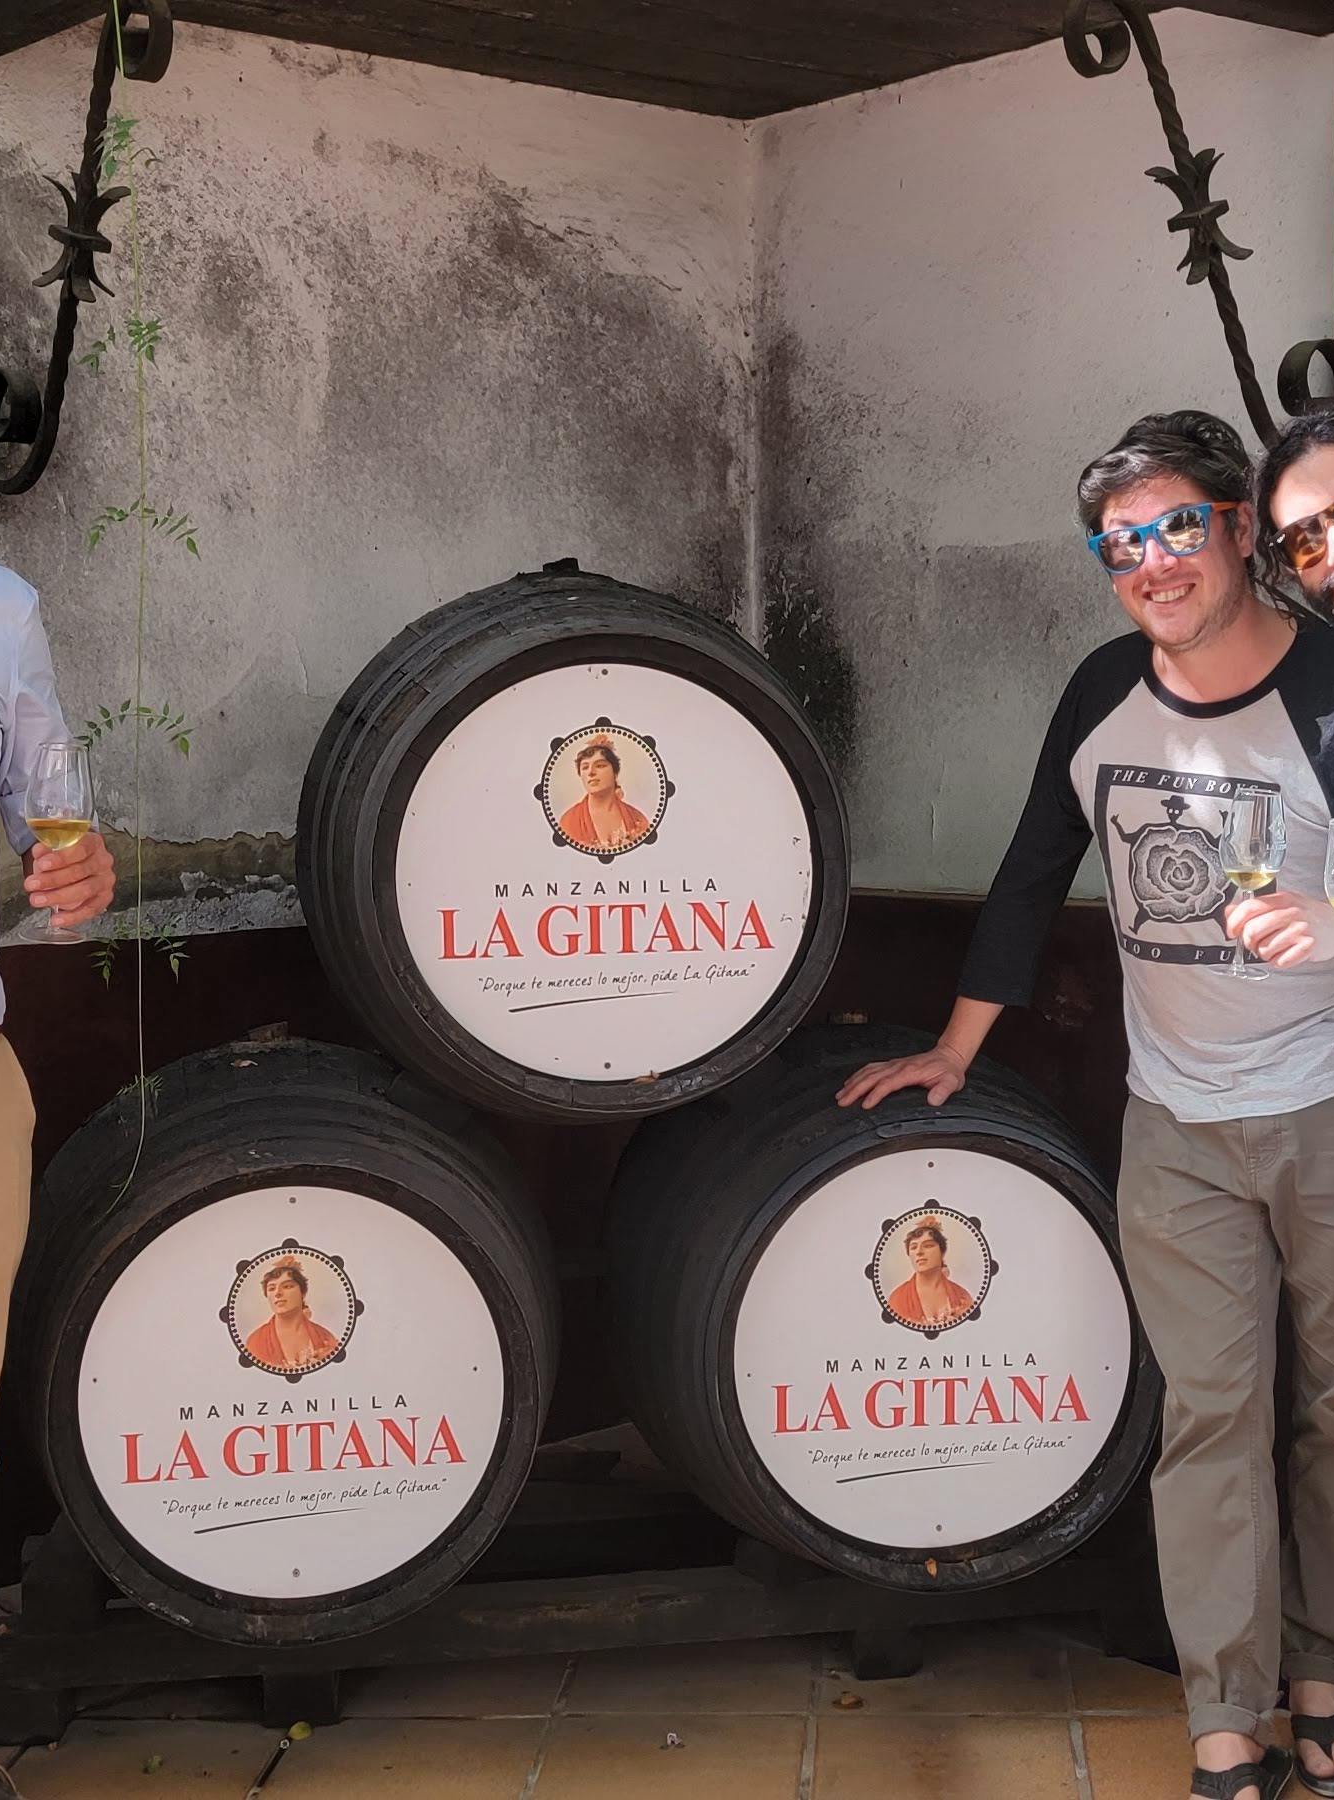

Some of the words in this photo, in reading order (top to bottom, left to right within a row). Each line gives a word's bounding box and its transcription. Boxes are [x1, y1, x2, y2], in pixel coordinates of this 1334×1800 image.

[1111, 769, 1148, 783] THE
[1157, 774, 1198, 790] FUN
[494, 878, 718, 899] MANZANILLA
[437, 906, 524, 960] LA
[535, 899, 775, 957] GITANA
[531, 976, 542, 989] te
[547, 976, 592, 988] mereces
[598, 972, 607, 985] lo
[651, 969, 678, 986] pide
[683, 965, 701, 980] La
[825, 1352, 1038, 1374] MANZANILLA
[178, 1393, 409, 1422] MANZANILLA
[771, 1382, 852, 1434] LA
[863, 1374, 1091, 1430] GITANA
[119, 1429, 209, 1485] LA
[221, 1414, 467, 1477] GITANA
[858, 1448, 869, 1460] te
[873, 1447, 916, 1459] mereces
[921, 1443, 930, 1456] lo
[971, 1440, 998, 1456] pide
[1002, 1436, 1020, 1451] La
[218, 1497, 229, 1510] te
[234, 1495, 280, 1508] mereces
[286, 1490, 295, 1503] lo
[340, 1485, 368, 1502] pide
[373, 1481, 391, 1496] La
